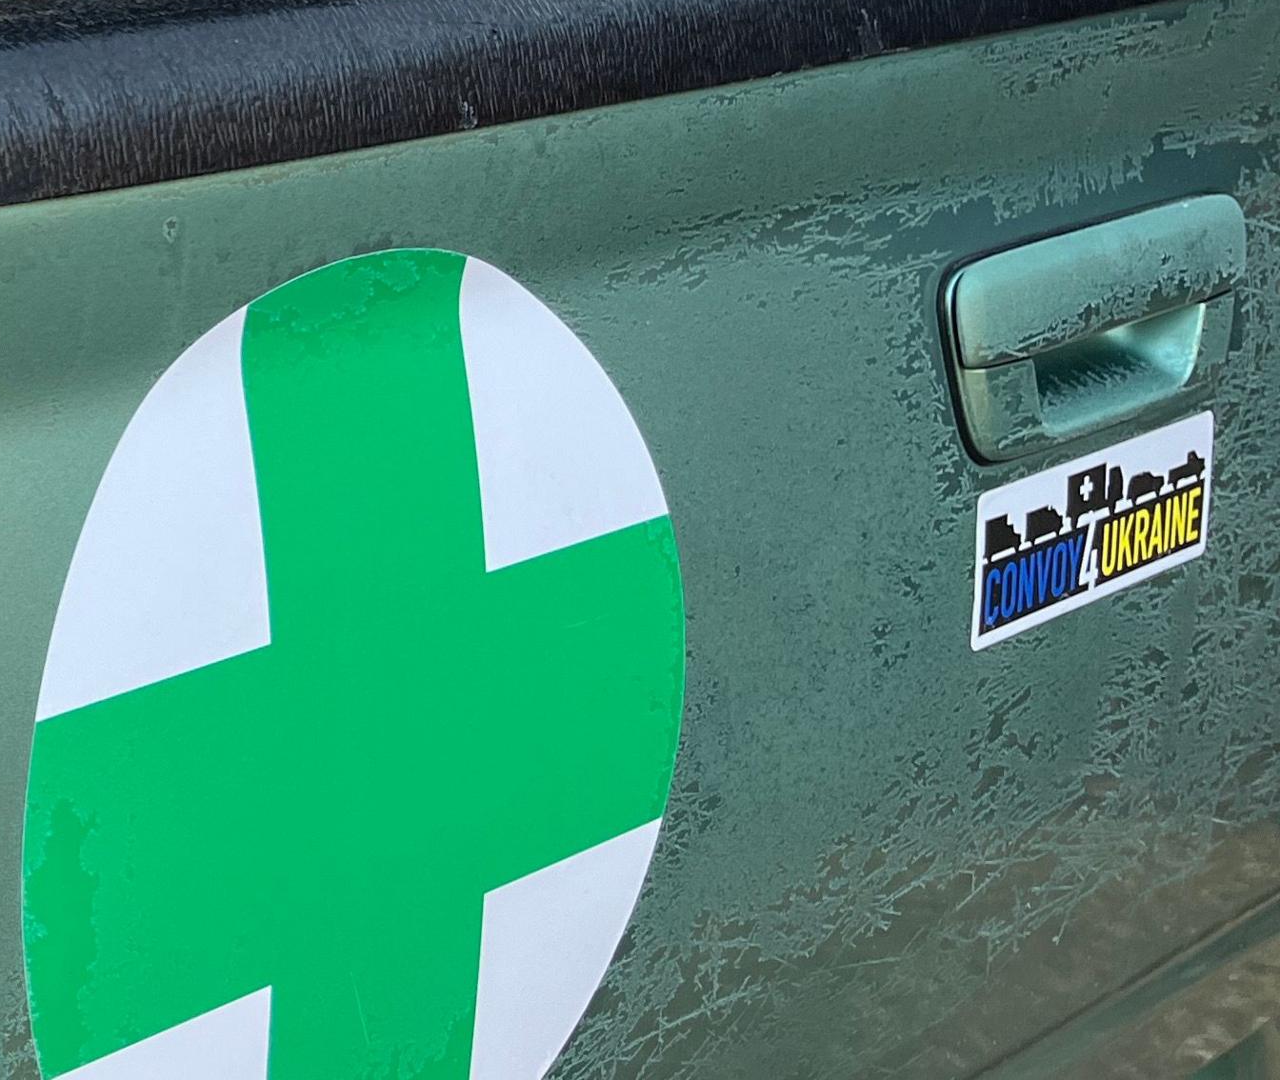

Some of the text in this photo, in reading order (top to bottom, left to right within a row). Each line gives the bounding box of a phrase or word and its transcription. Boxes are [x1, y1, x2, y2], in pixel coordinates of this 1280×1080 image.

[984, 487, 1202, 626] CONVOY 4 UKRAINE
